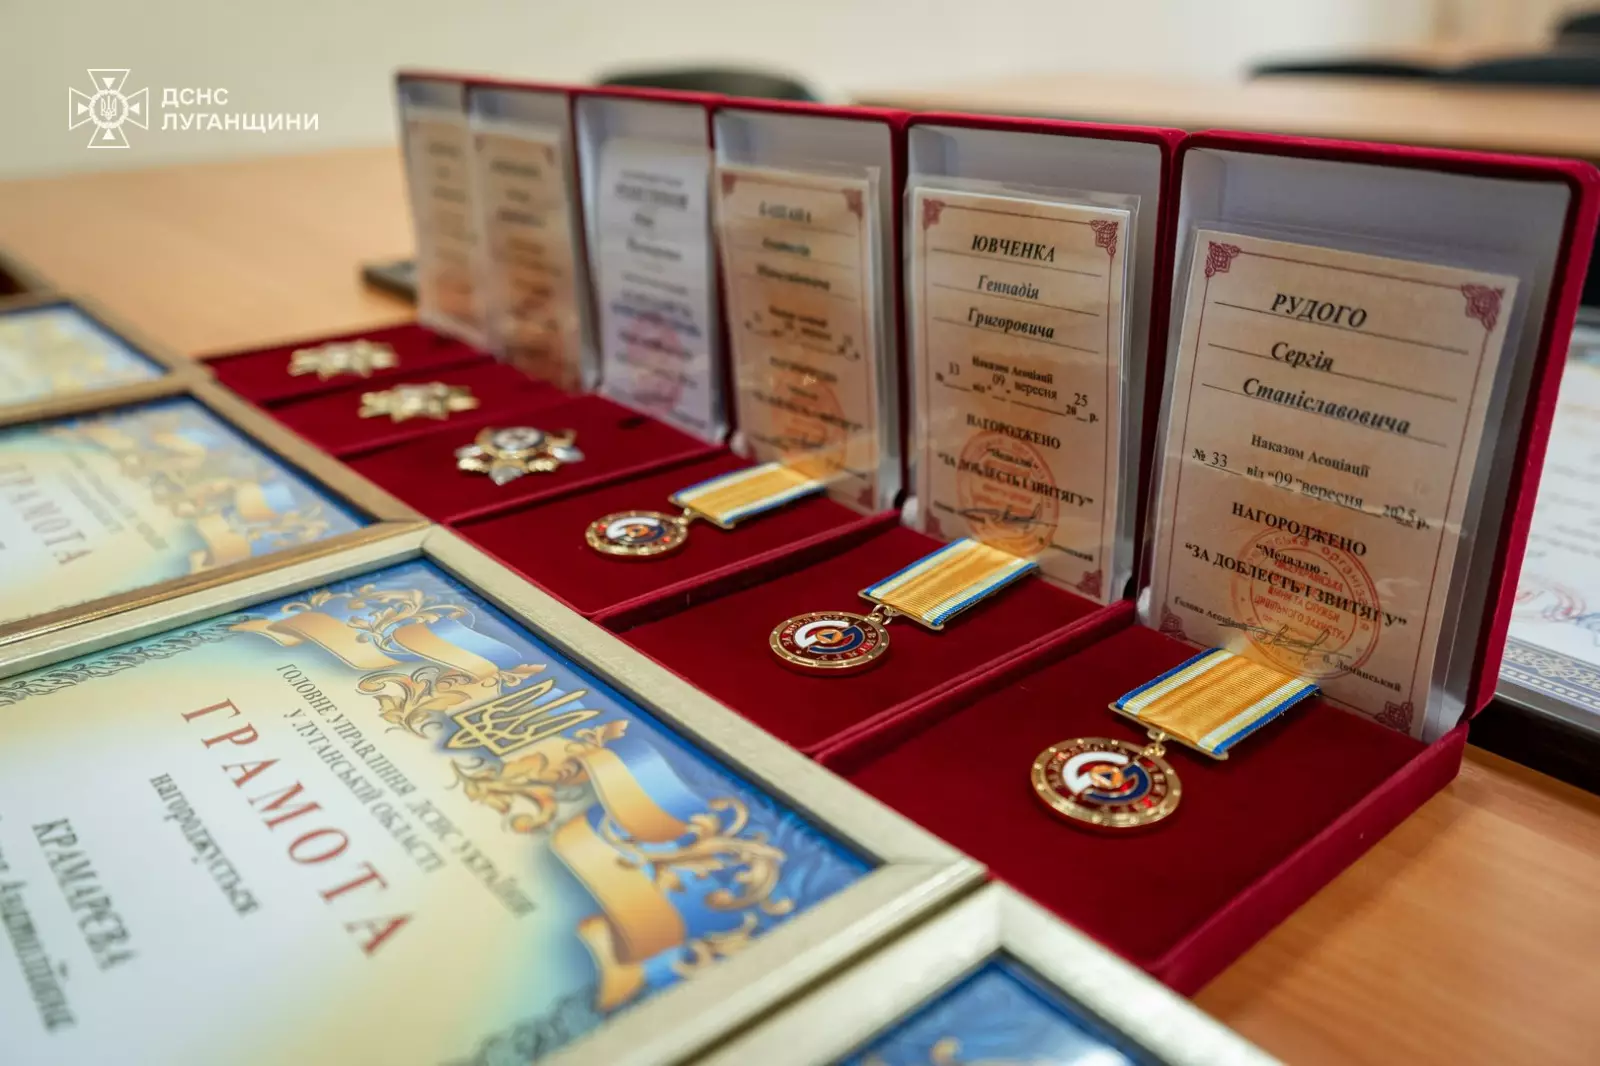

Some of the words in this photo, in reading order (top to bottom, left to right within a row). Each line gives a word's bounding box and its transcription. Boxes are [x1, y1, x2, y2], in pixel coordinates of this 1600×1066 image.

[971, 234, 1056, 262] ЮВЧЕНКА
[977, 275, 1040, 300] Геннадія
[967, 307, 1055, 339] Григоровича
[1271, 292, 1367, 329] РУДОГО
[1271, 341, 1335, 372] Сергія
[1241, 377, 1411, 436] Станіславовича
[966, 414, 1062, 450] НАГОРОДЖЕНО
[1192, 448, 1206, 462] №
[1211, 451, 1229, 468] 33
[1251, 434, 1305, 460] Наказом
[1307, 451, 1371, 479] Асоціації
[1231, 501, 1368, 558] НАГОРОДЖЕНО
[1212, 551, 1302, 596] ДОБЛЕСТЬ
[276, 663, 338, 724] ГОЛОВНЕ
[325, 712, 418, 798] УПРАВЛІННЯ
[283, 707, 307, 722] У
[291, 721, 387, 812] ЛУГАНСЬКІЙ
[148, 772, 262, 918] нагороджується
[180, 697, 416, 959] ГРАМОТА
